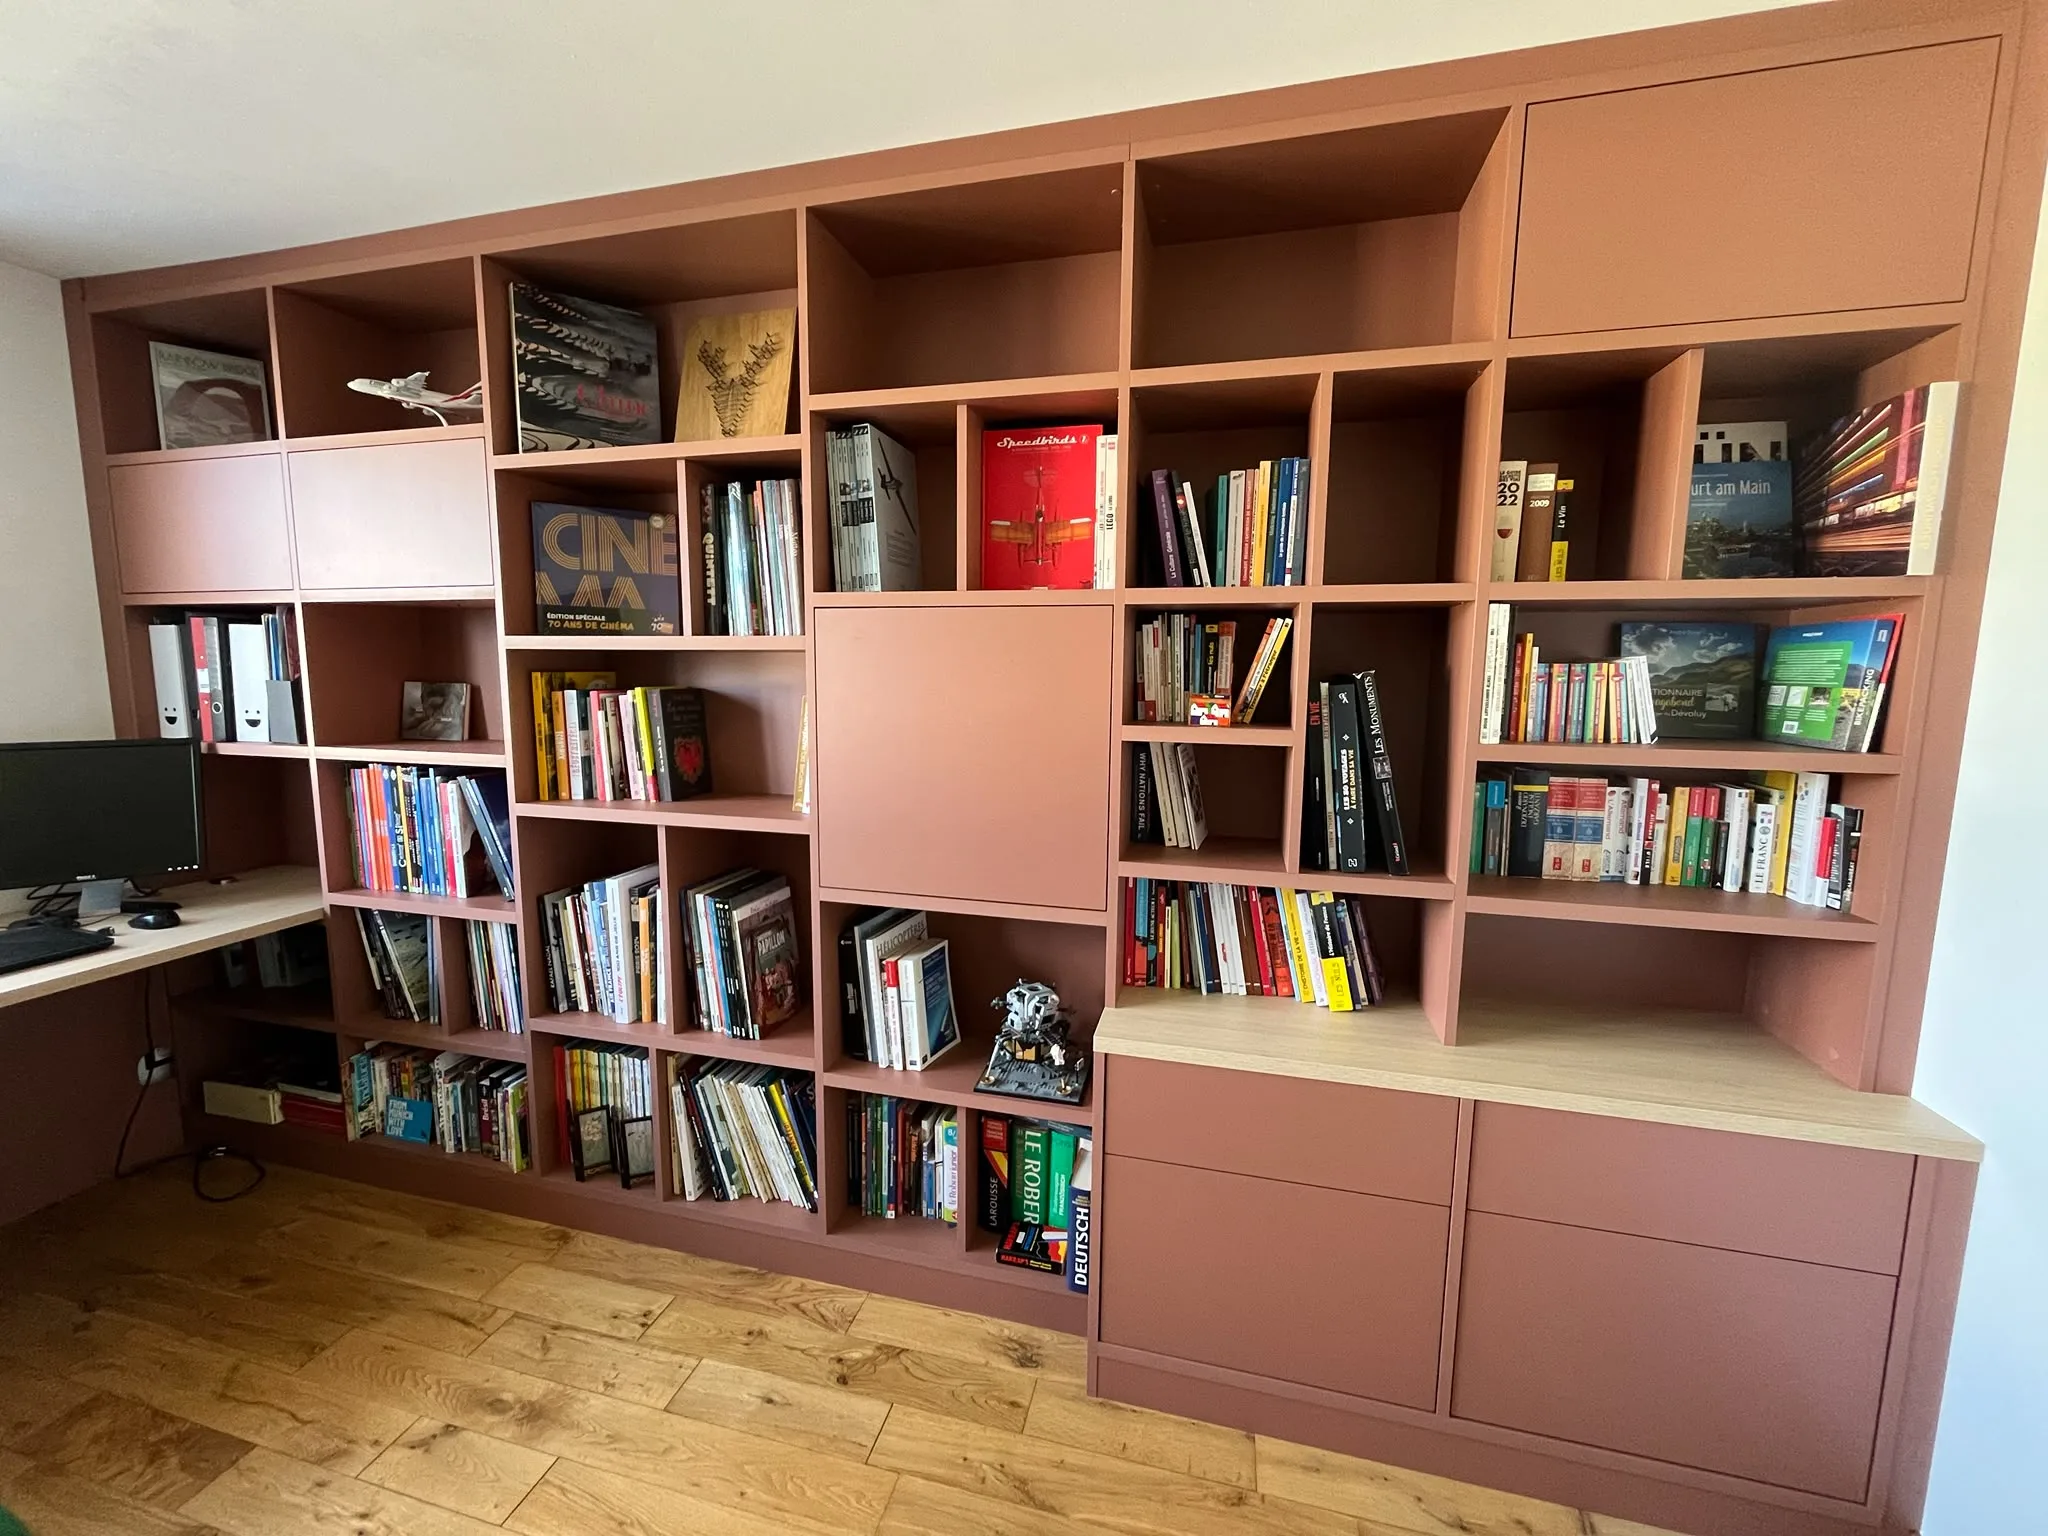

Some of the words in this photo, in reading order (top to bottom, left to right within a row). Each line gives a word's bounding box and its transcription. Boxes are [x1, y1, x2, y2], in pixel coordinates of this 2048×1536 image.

[997, 435, 1078, 450] Speedbirds
[1497, 482, 1520, 494] 20
[1716, 482, 1736, 496] am
[1739, 479, 1771, 496] Main
[1497, 494, 1518, 507] 22
[1529, 499, 1551, 508] 2009
[1558, 505, 1567, 519] Vin
[1106, 513, 1115, 531] LEGO
[1557, 519, 1565, 529] Le
[543, 512, 678, 577] CINÉ
[546, 612, 574, 620] ÉDITION
[575, 613, 606, 622] SPÉCIALE
[548, 619, 561, 628] 70
[563, 620, 583, 629] ANS
[585, 621, 598, 630] DE
[600, 620, 635, 631] CINÉMA
[1363, 675, 1381, 735] MONUMENTS
[1853, 668, 1875, 726] BIKEPACKING
[1309, 700, 1320, 713] VIE
[1310, 713, 1320, 726] EN
[1374, 737, 1384, 754] LES
[1139, 752, 1147, 768] WHY
[1340, 748, 1349, 784] VOYAGES
[1138, 771, 1146, 810] NATIONS
[1137, 813, 1146, 830] FAIL
[1757, 837, 1769, 869] FRANC
[1755, 871, 1765, 884] LE
[1322, 906, 1330, 925] France
[757, 929, 786, 955] PAPILLON
[876, 918, 926, 958] HÉLICOPTÈRES
[1326, 931, 1335, 956] L'Histoire
[386, 1126, 405, 1137] LOVE
[1024, 1131, 1042, 1154] LE
[1023, 1158, 1042, 1224] ROBER
[989, 1177, 999, 1227] LAROUSSE
[1074, 1206, 1090, 1287] DEUTSCH
